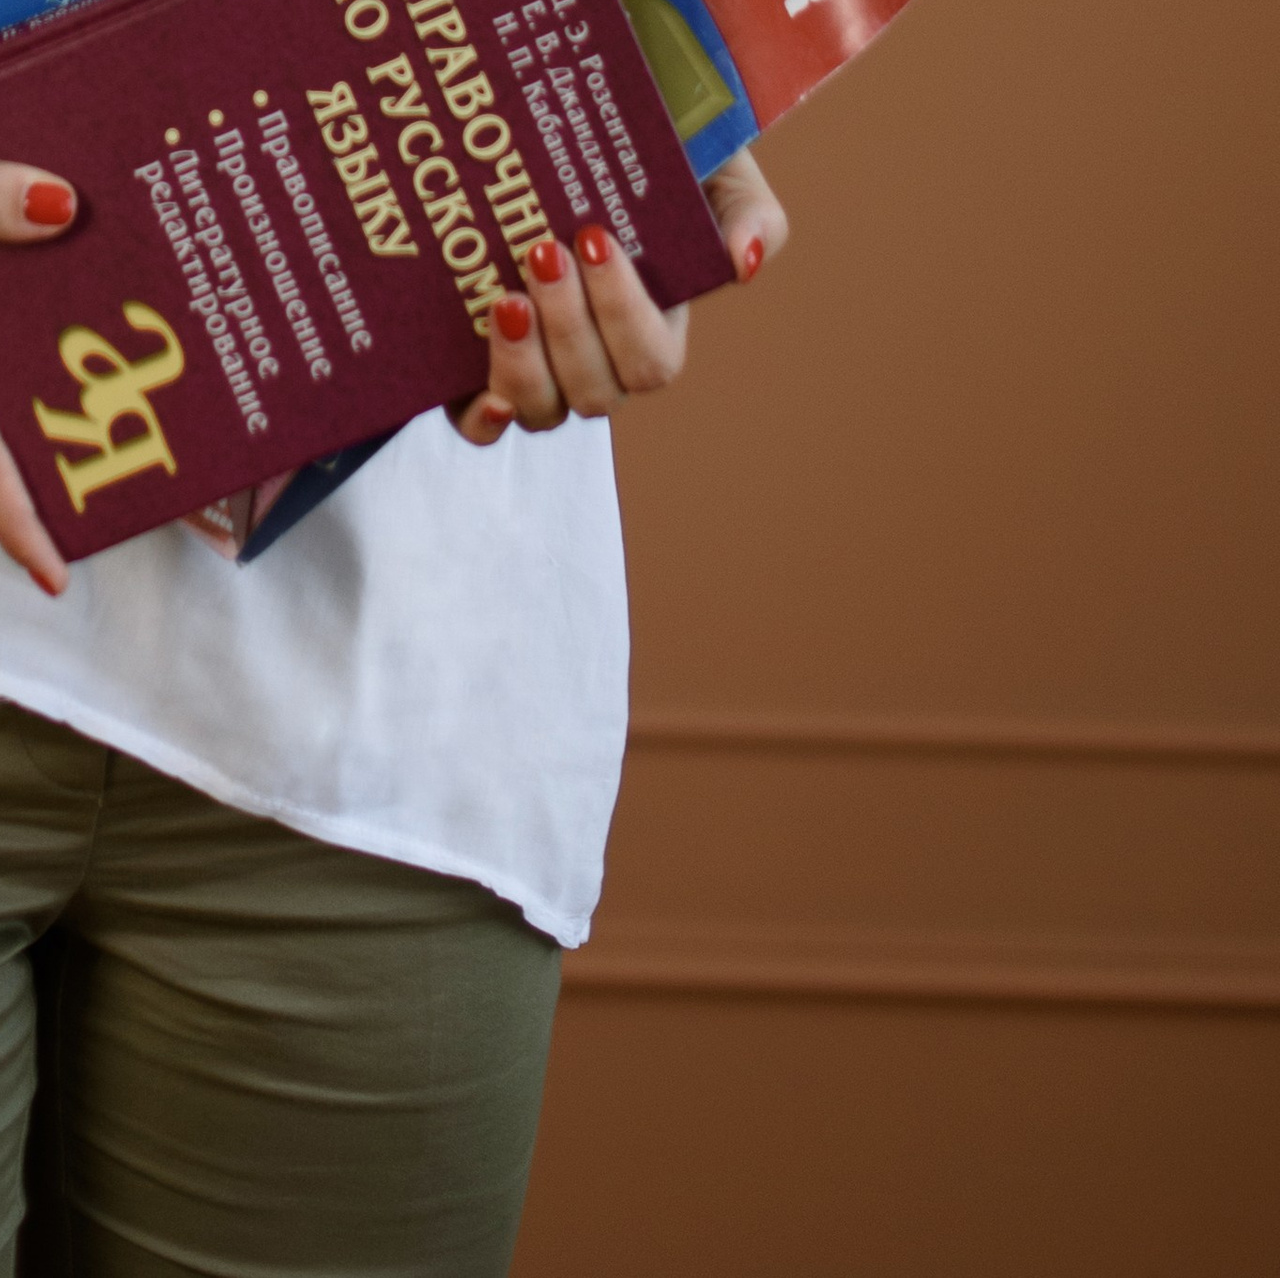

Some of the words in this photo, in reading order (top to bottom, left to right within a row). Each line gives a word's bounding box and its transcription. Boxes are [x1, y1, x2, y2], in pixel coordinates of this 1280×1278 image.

[492, 11, 520, 45] Н.
[507, 46, 534, 79] П.
[522, 79, 591, 217] Кабанова
[521, 0, 547, 30] Е.
[535, 31, 561, 63] В.
[564, 20, 590, 53] Э.
[579, 54, 648, 198] Розенталь
[168, 149, 280, 380] Литературное
[213, 128, 332, 380] Произношение
[257, 109, 372, 353] Правописание
[306, 81, 419, 257] ЯЗЫКУ
[366, 52, 507, 339] РУССКОМ
[545, 66, 644, 259] Джанджакова
[134, 160, 268, 436] редактирование
